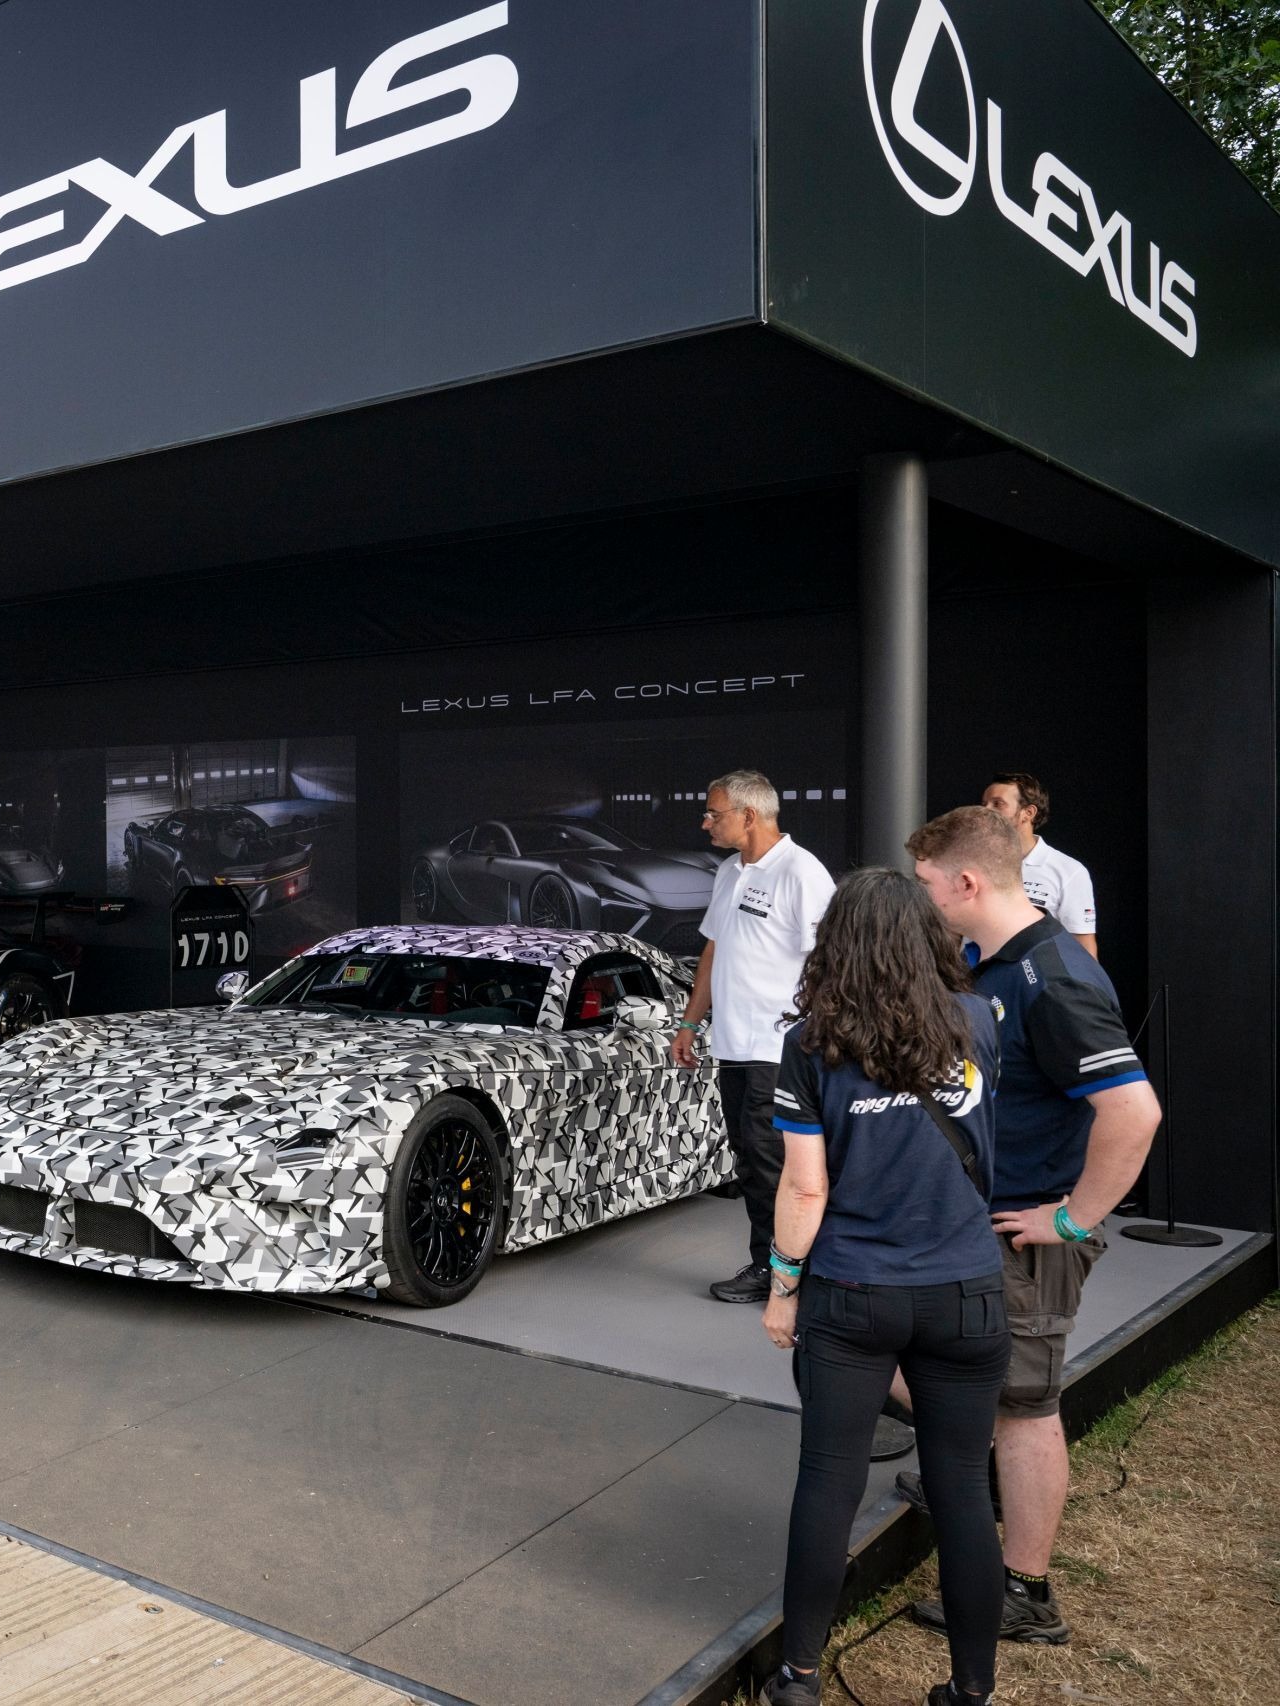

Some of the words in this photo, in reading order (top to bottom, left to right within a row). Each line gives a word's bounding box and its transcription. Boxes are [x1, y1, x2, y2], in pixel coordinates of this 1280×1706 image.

[987, 97, 1197, 358] LEXUS
[401, 694, 510, 713] LEXUS
[529, 688, 597, 705] LFA
[613, 673, 805, 699] CONCEPT
[177, 930, 249, 967] 1710
[849, 1096, 893, 1115] Ring
[891, 1088, 966, 1107] Raing
